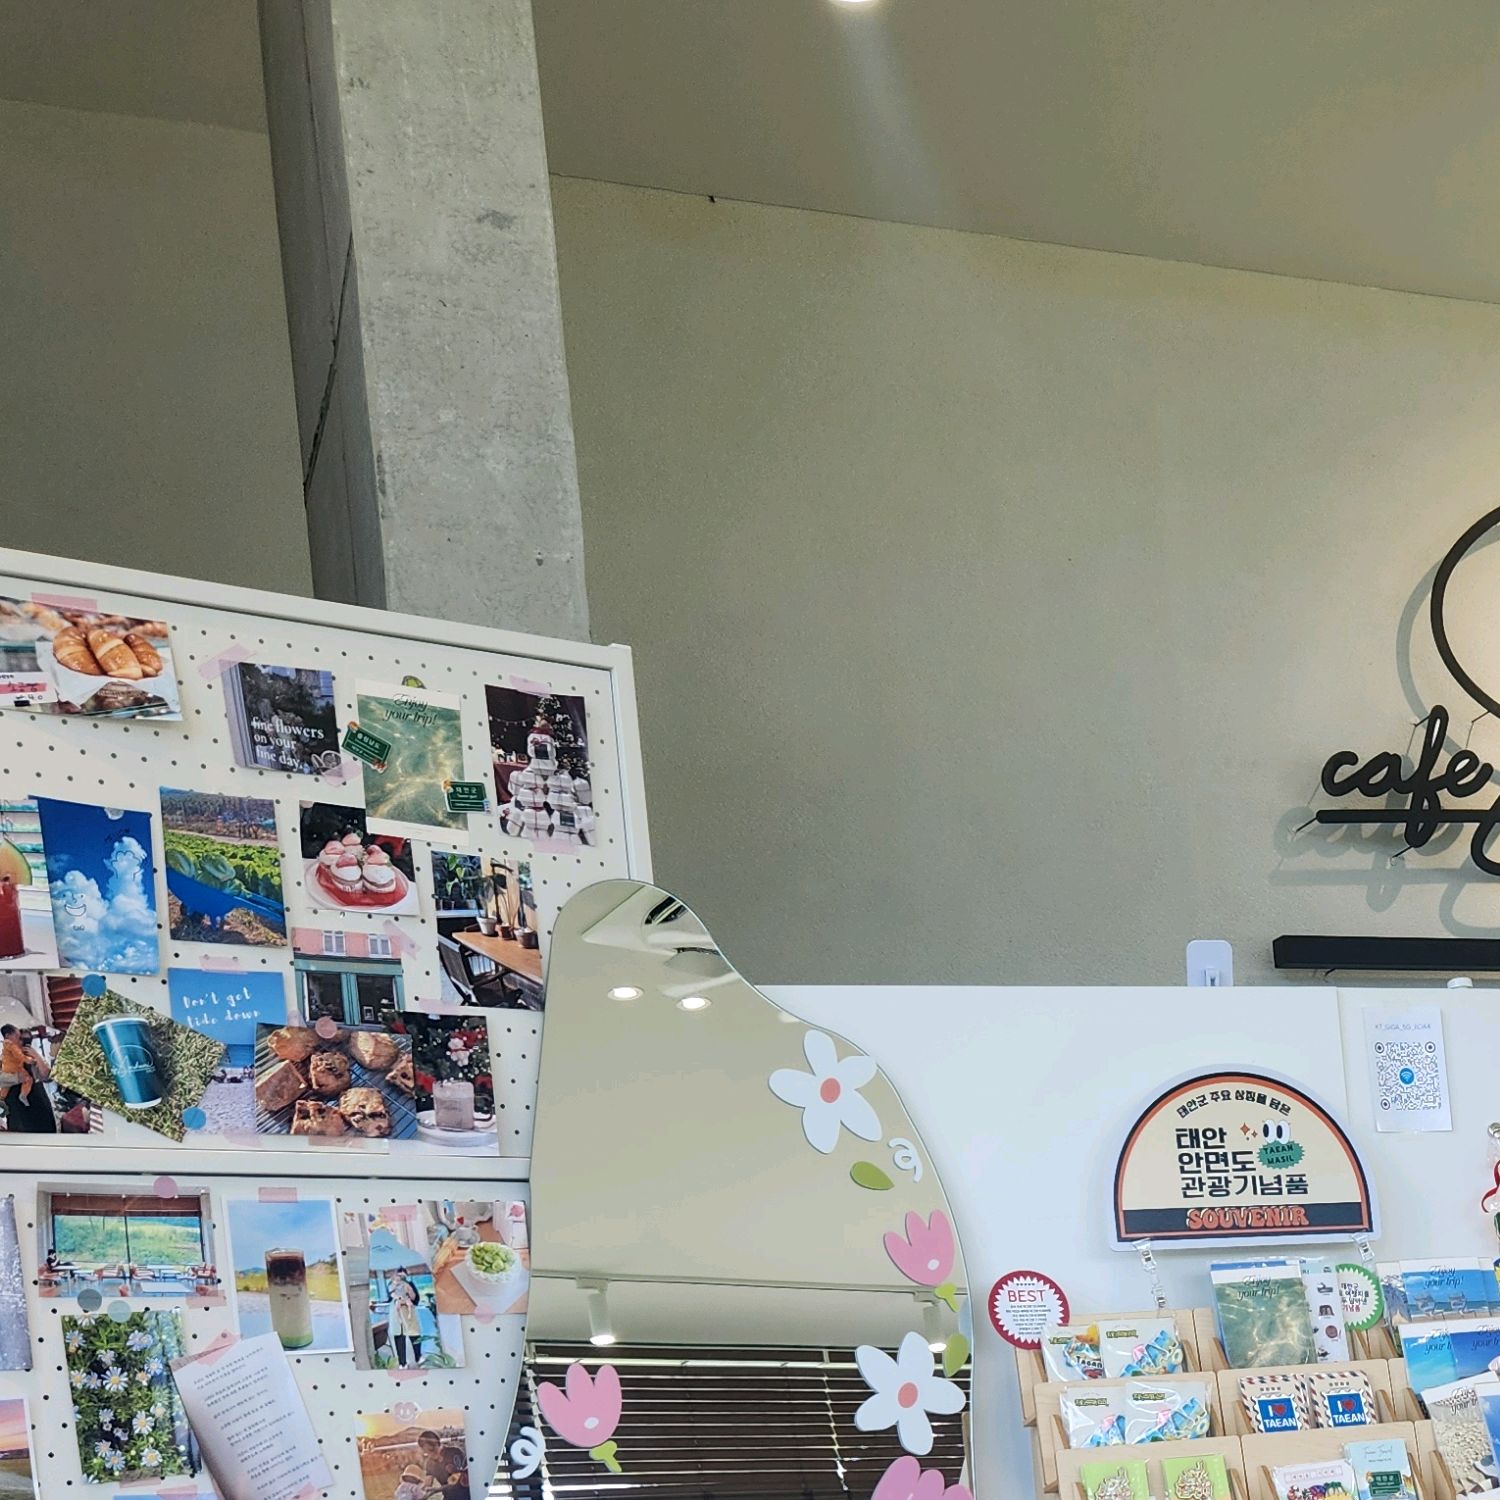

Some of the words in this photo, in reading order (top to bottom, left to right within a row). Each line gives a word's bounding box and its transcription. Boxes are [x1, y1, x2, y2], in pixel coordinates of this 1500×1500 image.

[392, 692, 428, 713] Enjoy
[384, 709, 413, 724] your
[413, 711, 438, 728] trip!
[251, 716, 273, 732] fine
[275, 717, 325, 740] flowers
[253, 734, 268, 745] on
[269, 736, 297, 750] your
[255, 744, 276, 762] fine
[1320, 705, 1494, 848] cafe
[183, 992, 219, 1009] Don't
[226, 987, 252, 1007] get
[225, 1008, 261, 1022] down
[1176, 1094, 1209, 1118] 태안군
[1209, 1090, 1232, 1102] 주요
[1175, 1127, 1227, 1149] 태안
[1263, 1144, 1294, 1154] TAEAN
[1178, 1150, 1256, 1174] 안면도
[1267, 1154, 1295, 1164] MASIL
[1181, 1173, 1309, 1199] 관광기념품
[1186, 1205, 1309, 1230] SOUVENIR
[1424, 1277, 1444, 1289] your
[1445, 1275, 1464, 1289] trip!
[1007, 1289, 1046, 1303] BEST
[1237, 1286, 1260, 1301] your
[1261, 1285, 1280, 1299] trip!
[1425, 1341, 1445, 1355] your
[1471, 1337, 1491, 1350] your
[1263, 1416, 1297, 1428] TAEAN
[1333, 1412, 1365, 1424] TAEAN
